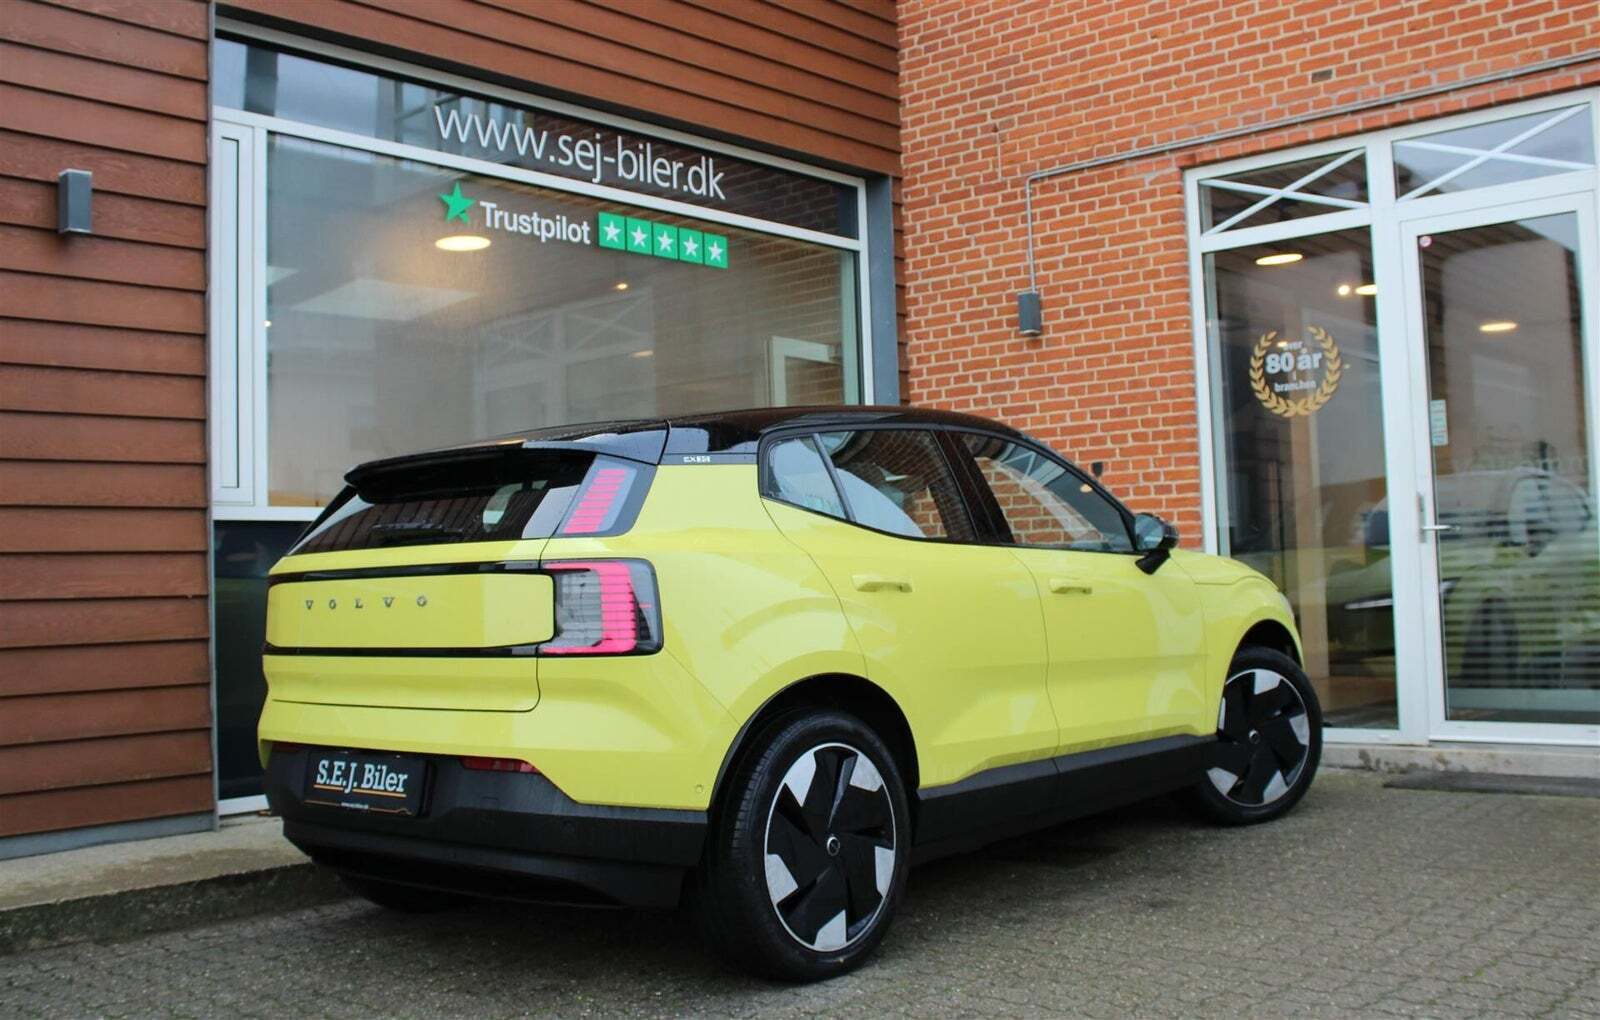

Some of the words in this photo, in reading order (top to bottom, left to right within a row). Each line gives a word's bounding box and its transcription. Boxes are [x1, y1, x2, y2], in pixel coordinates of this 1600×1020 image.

[434, 105, 726, 200] www.sej-biler.dk
[479, 200, 592, 245] Trustpilot
[1265, 352, 1295, 374] 80
[1296, 347, 1323, 371] år
[304, 595, 429, 611] VOLVO
[315, 759, 359, 794] S.E.J.
[361, 763, 408, 793] Biler
